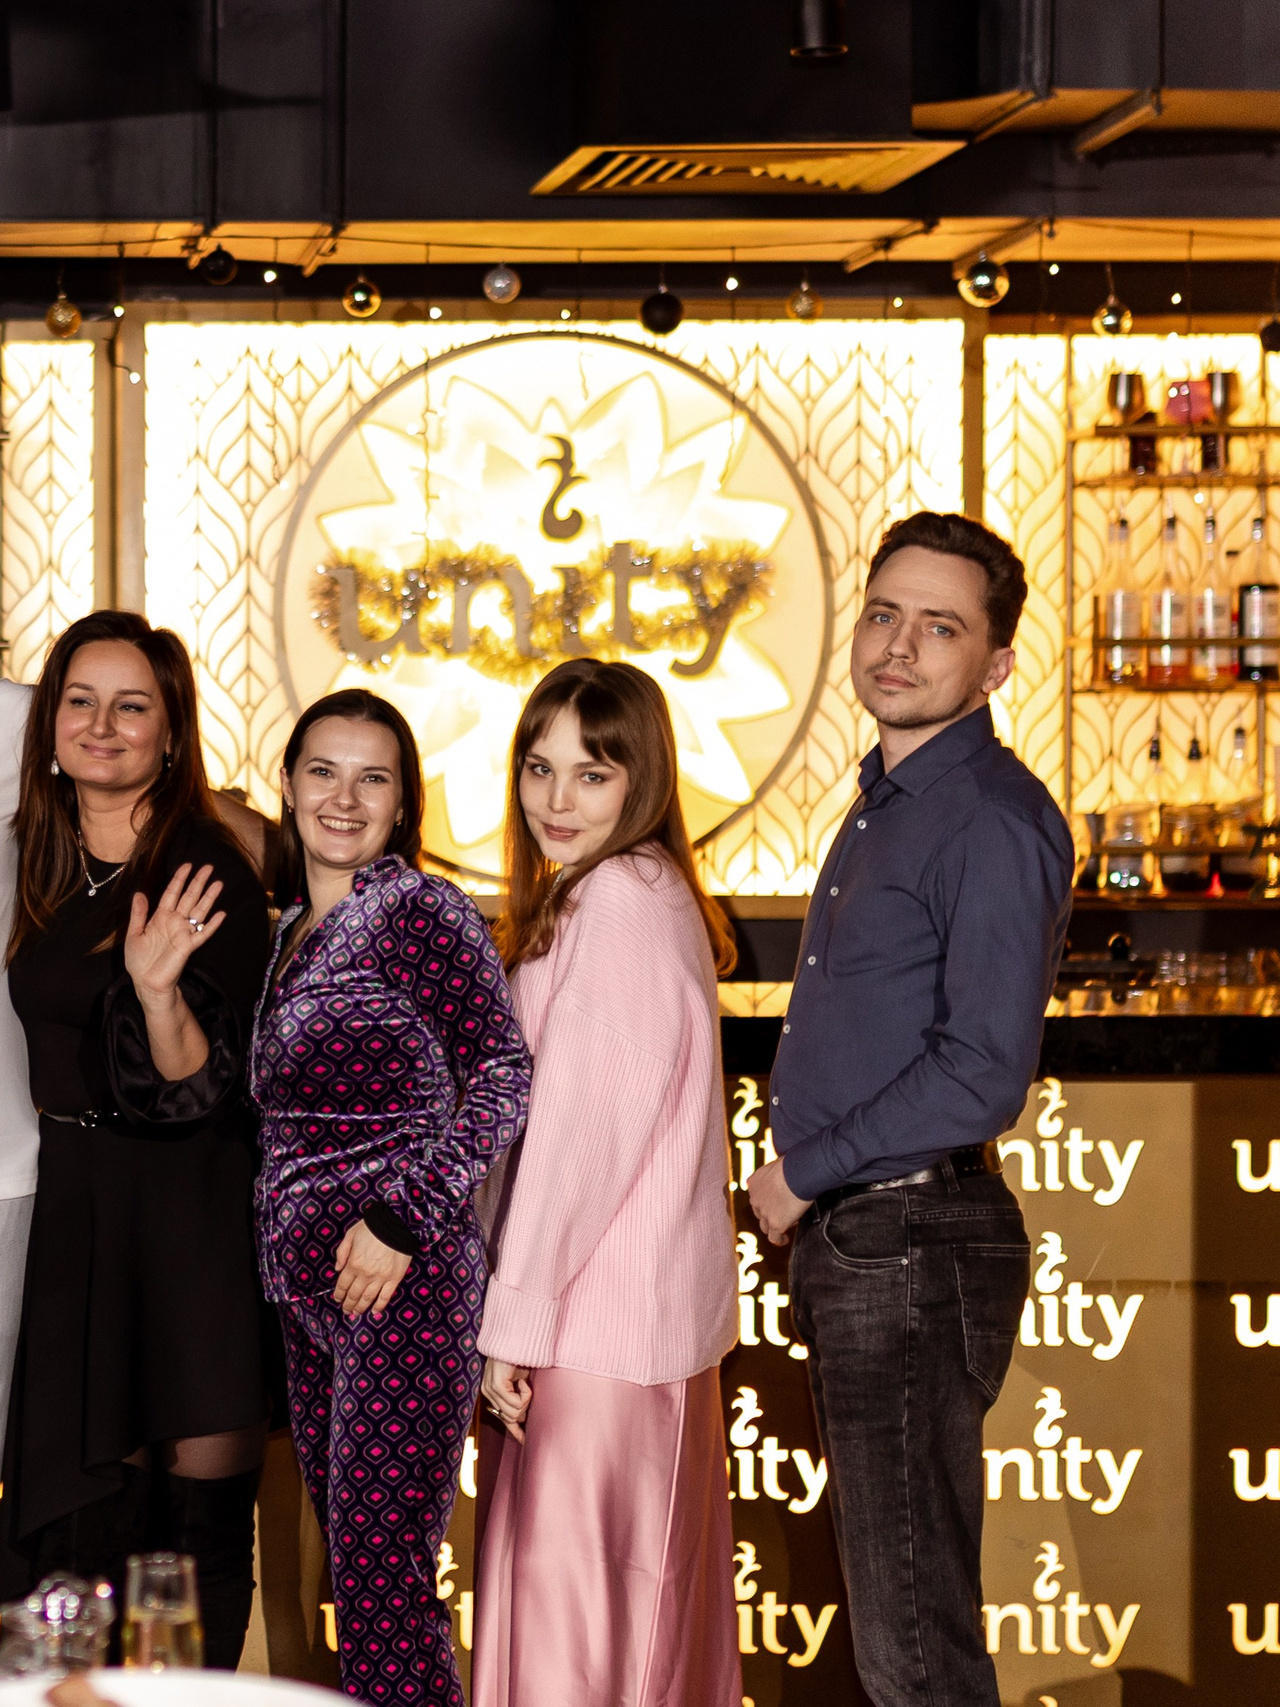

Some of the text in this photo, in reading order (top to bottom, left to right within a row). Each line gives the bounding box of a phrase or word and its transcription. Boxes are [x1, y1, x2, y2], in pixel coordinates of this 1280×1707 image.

[327, 542, 765, 677] unity
[997, 1128, 1144, 1206] nity
[726, 1437, 828, 1514] ity
[981, 1437, 1143, 1514] nity
[735, 1592, 838, 1667] ity
[981, 1592, 1141, 1667] nity
